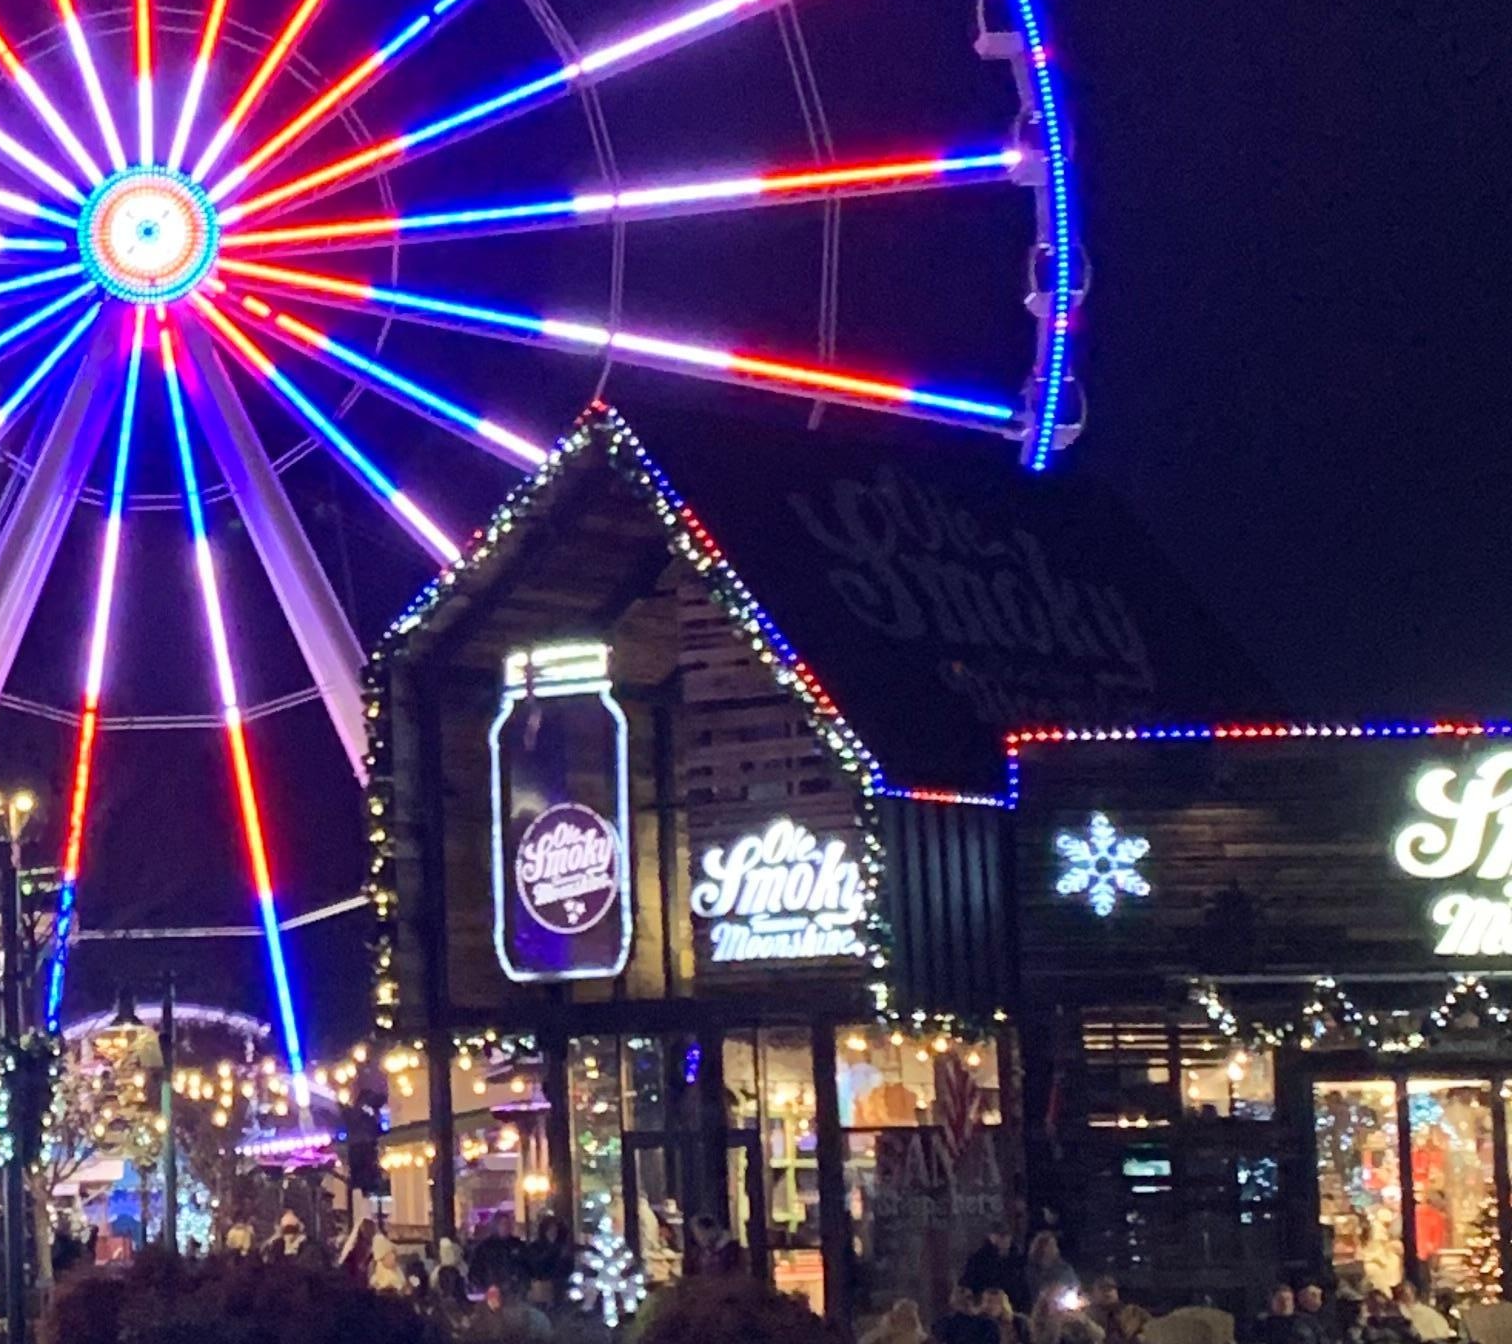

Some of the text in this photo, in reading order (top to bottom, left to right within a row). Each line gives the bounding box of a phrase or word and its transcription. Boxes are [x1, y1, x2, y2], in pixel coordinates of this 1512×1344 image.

[522, 828, 613, 883] Smoky
[762, 816, 823, 864] Ole
[711, 921, 866, 962] Moonshine
